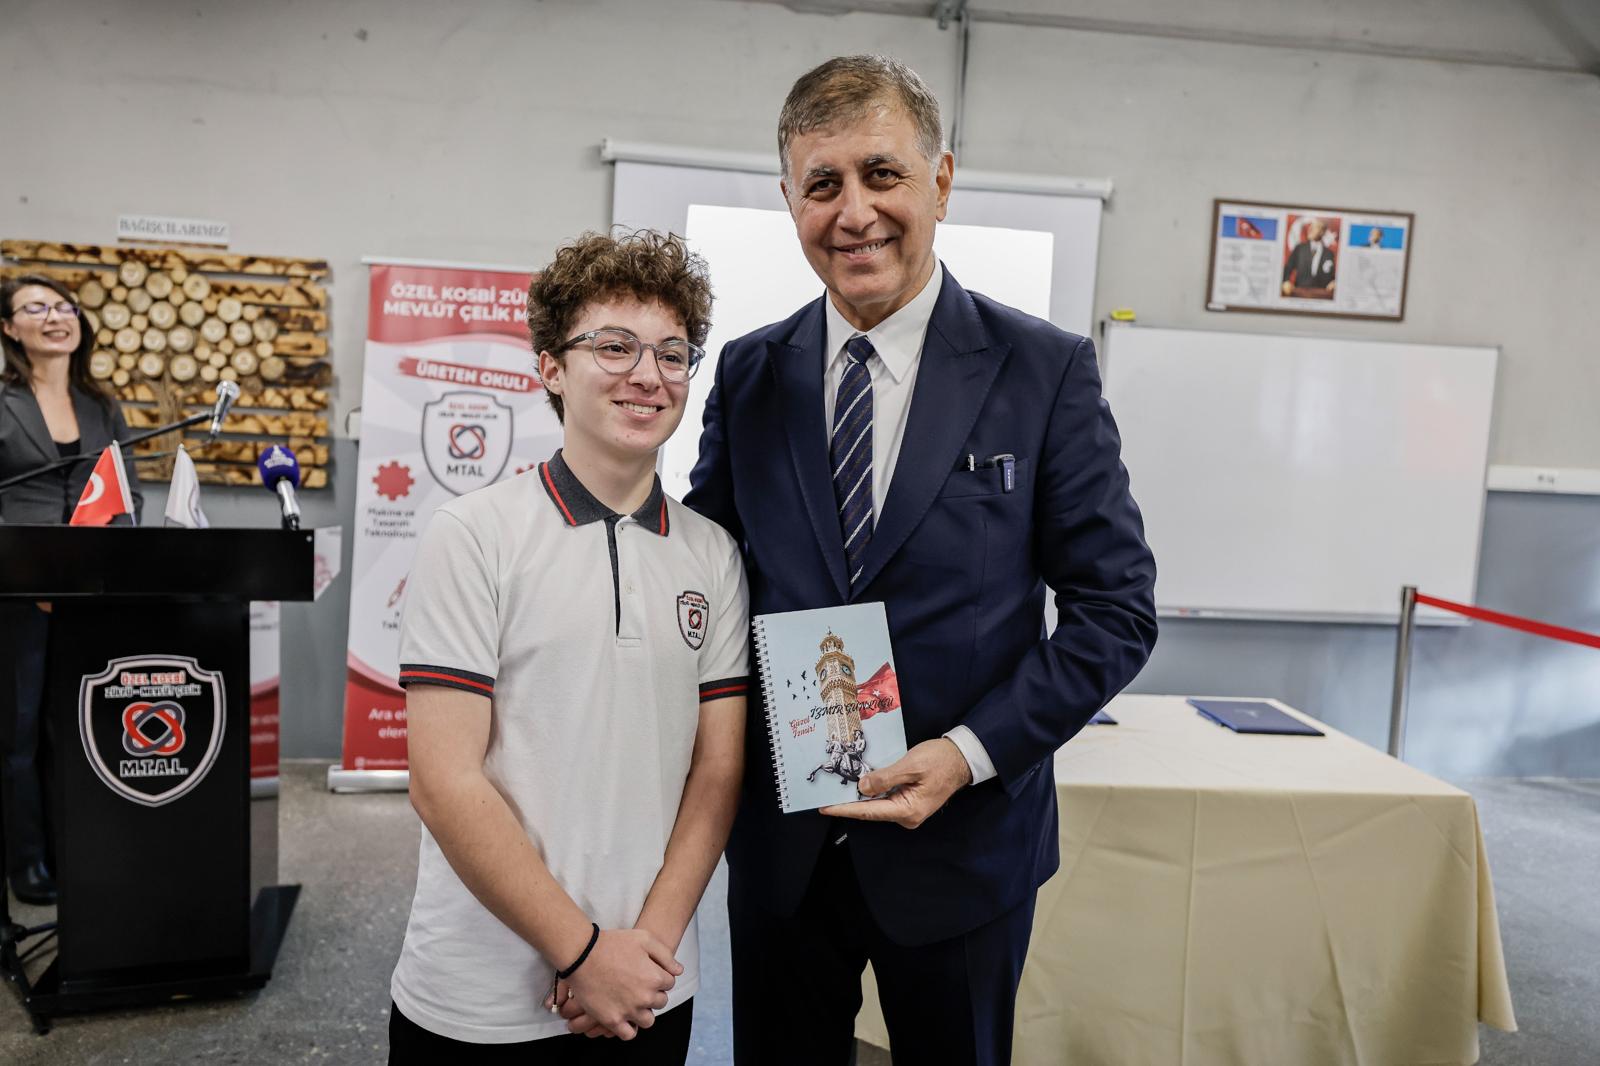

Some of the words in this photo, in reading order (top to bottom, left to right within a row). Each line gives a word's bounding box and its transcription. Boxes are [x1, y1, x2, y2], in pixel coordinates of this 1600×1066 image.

[391, 281, 437, 300] ÖZEL
[442, 285, 496, 304] KOSBİ
[383, 300, 456, 320] MEVLÜT
[460, 303, 511, 324] ÇELİK
[447, 464, 485, 478] MTAL
